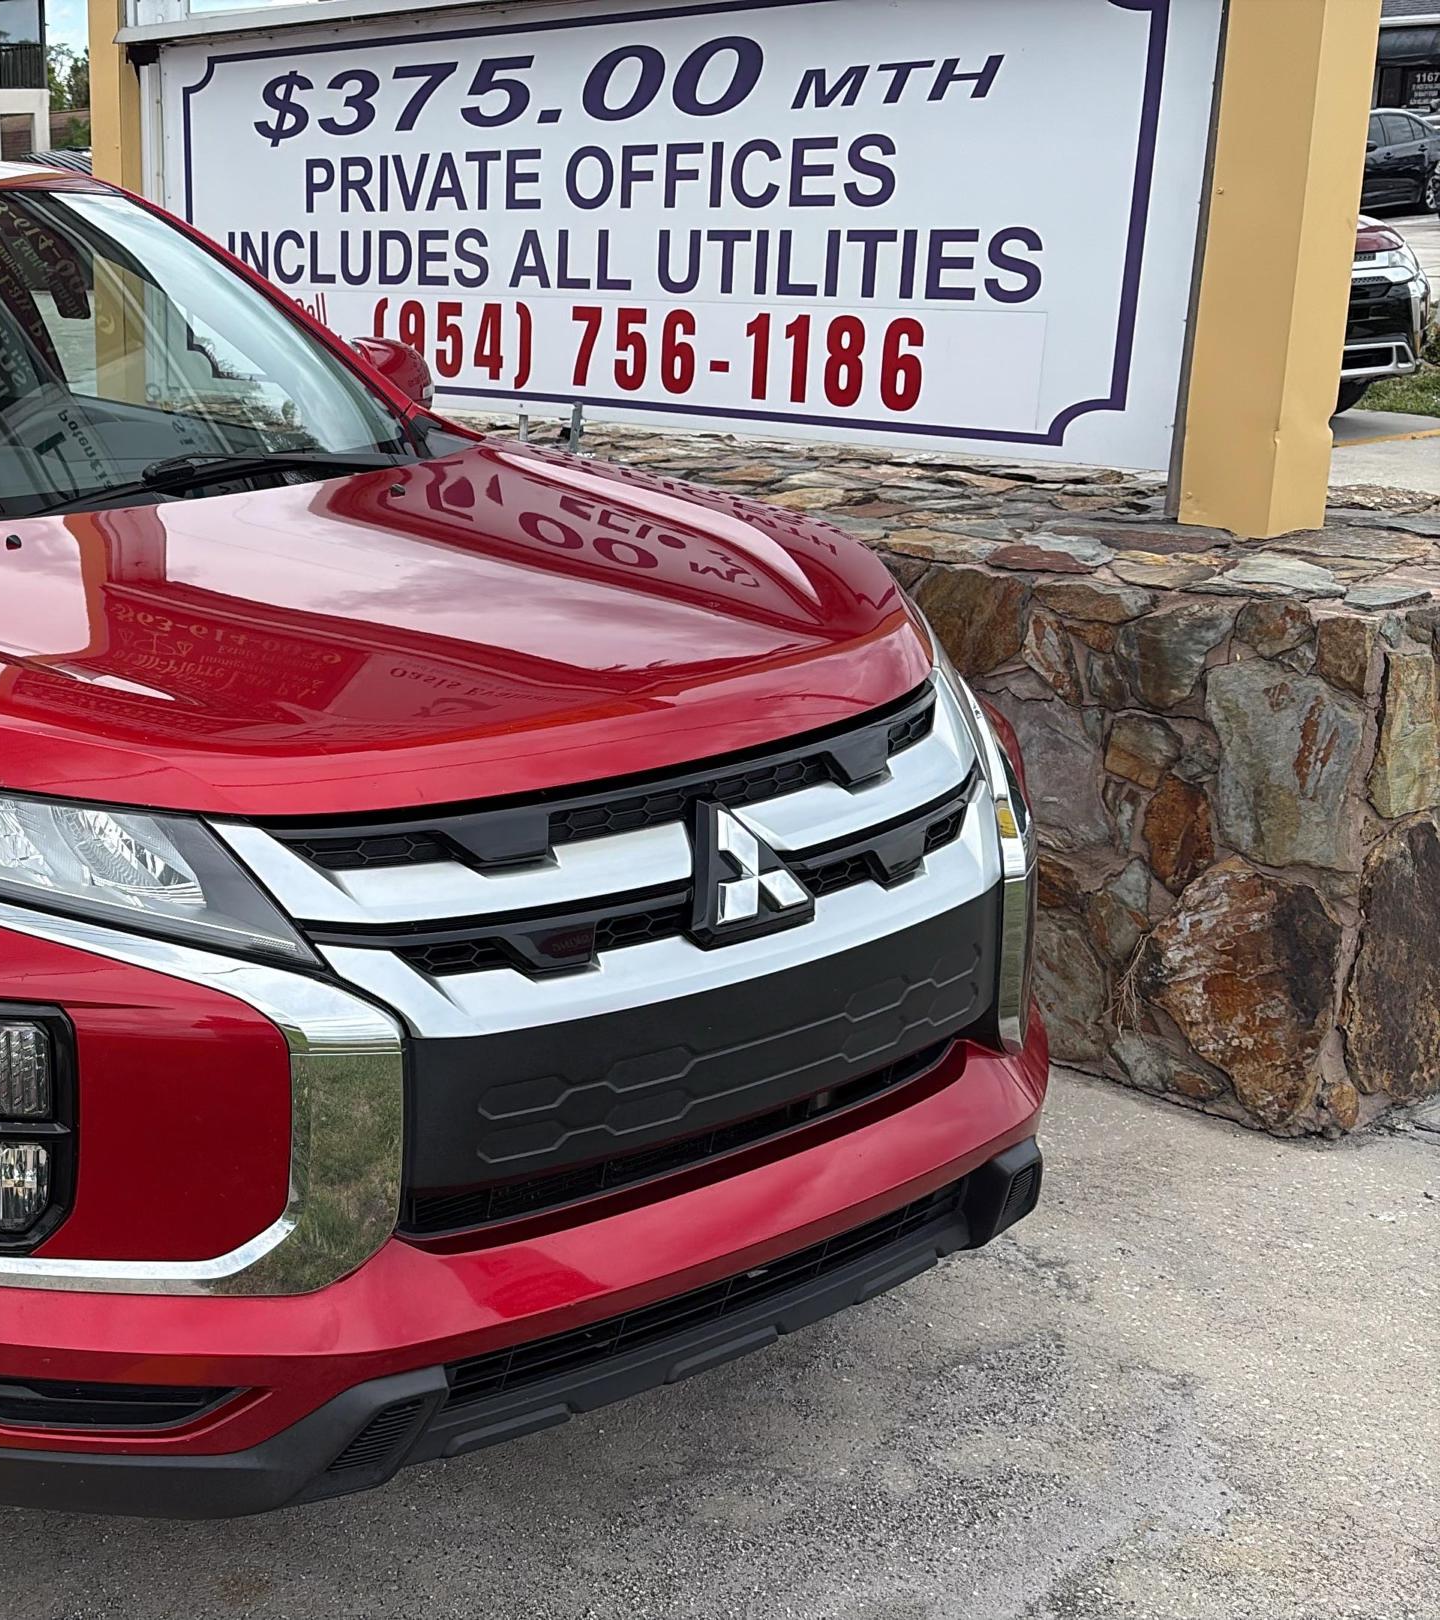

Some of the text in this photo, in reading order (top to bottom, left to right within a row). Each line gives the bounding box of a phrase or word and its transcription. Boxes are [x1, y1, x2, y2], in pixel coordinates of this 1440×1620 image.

[253, 35, 1006, 148] $375.00 MTH
[305, 133, 896, 213] PRIVATE OFFICES
[508, 229, 632, 291] ALL
[657, 226, 1044, 302] UTILITIES
[571, 305, 925, 412] 756-1186
